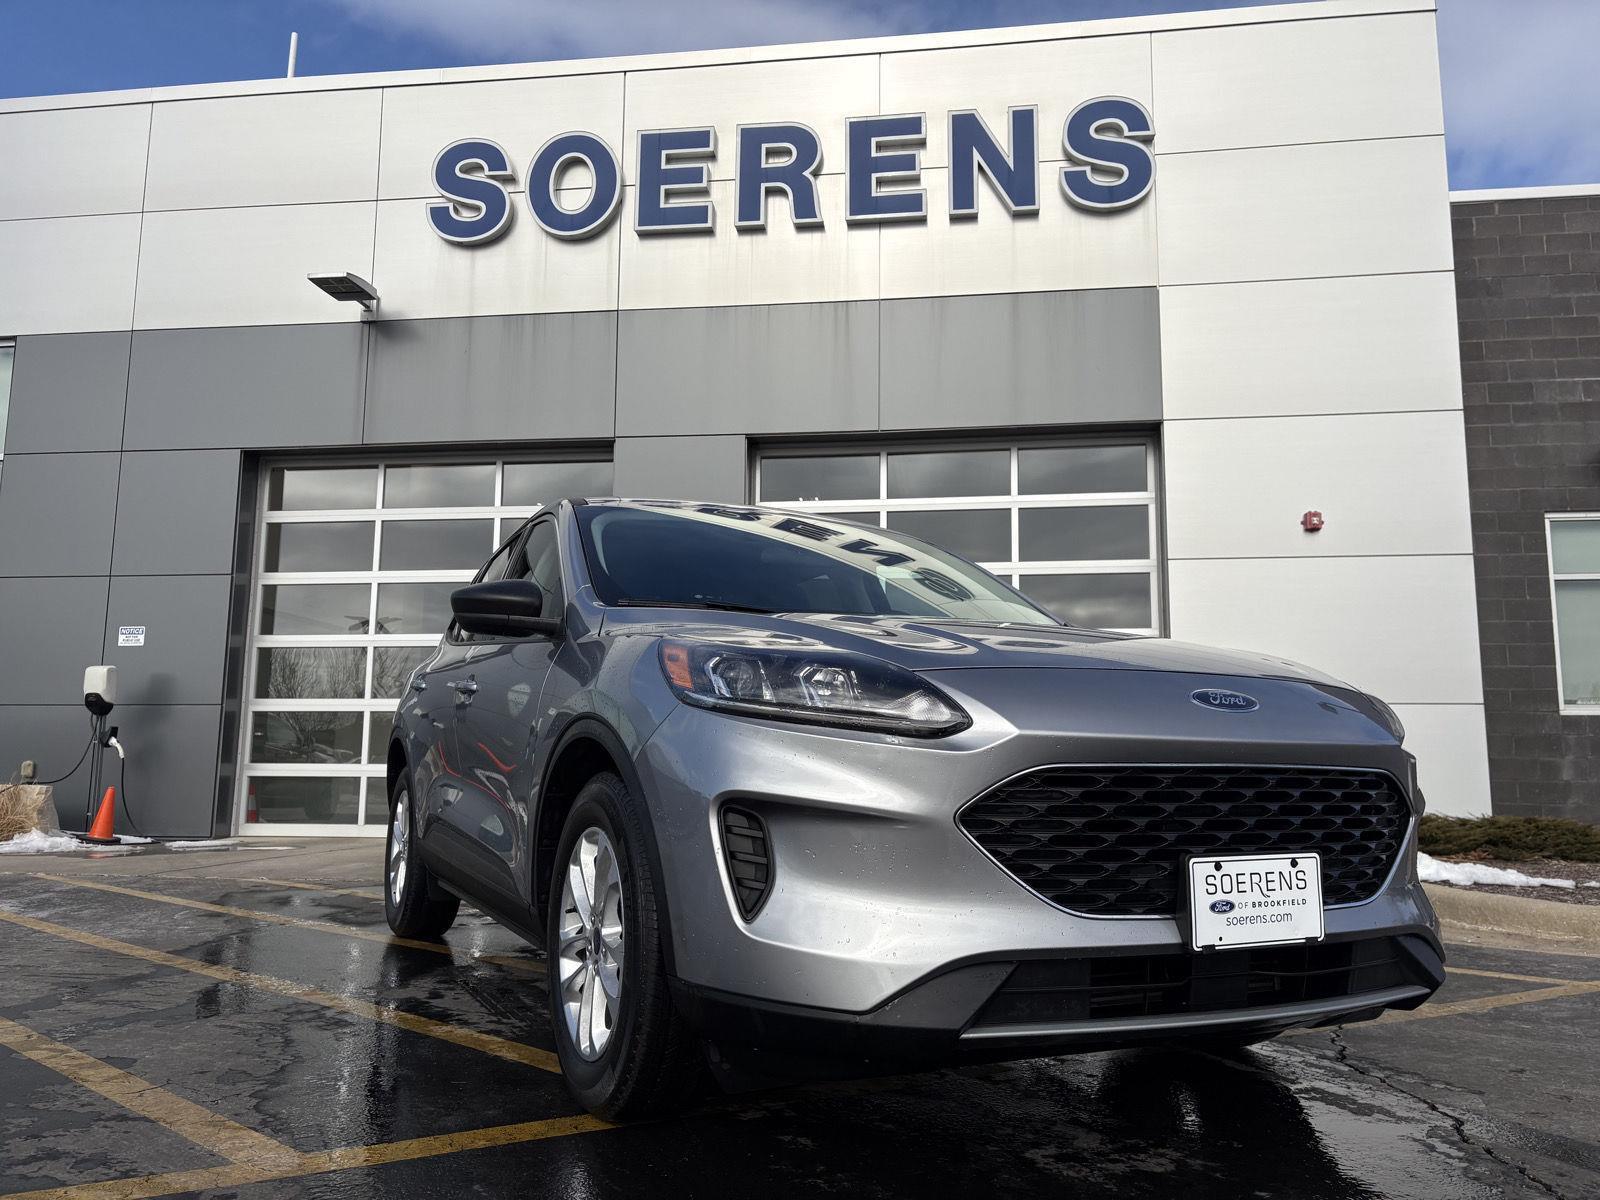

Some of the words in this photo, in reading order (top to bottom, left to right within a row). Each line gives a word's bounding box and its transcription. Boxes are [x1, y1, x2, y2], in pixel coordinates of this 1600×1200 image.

[426, 96, 1157, 246] SOERENS
[1208, 690, 1246, 706] Ford
[1205, 870, 1307, 898] SOERENS
[1251, 898, 1307, 908] BROOKFIELD
[1226, 912, 1293, 926] soerens.com
